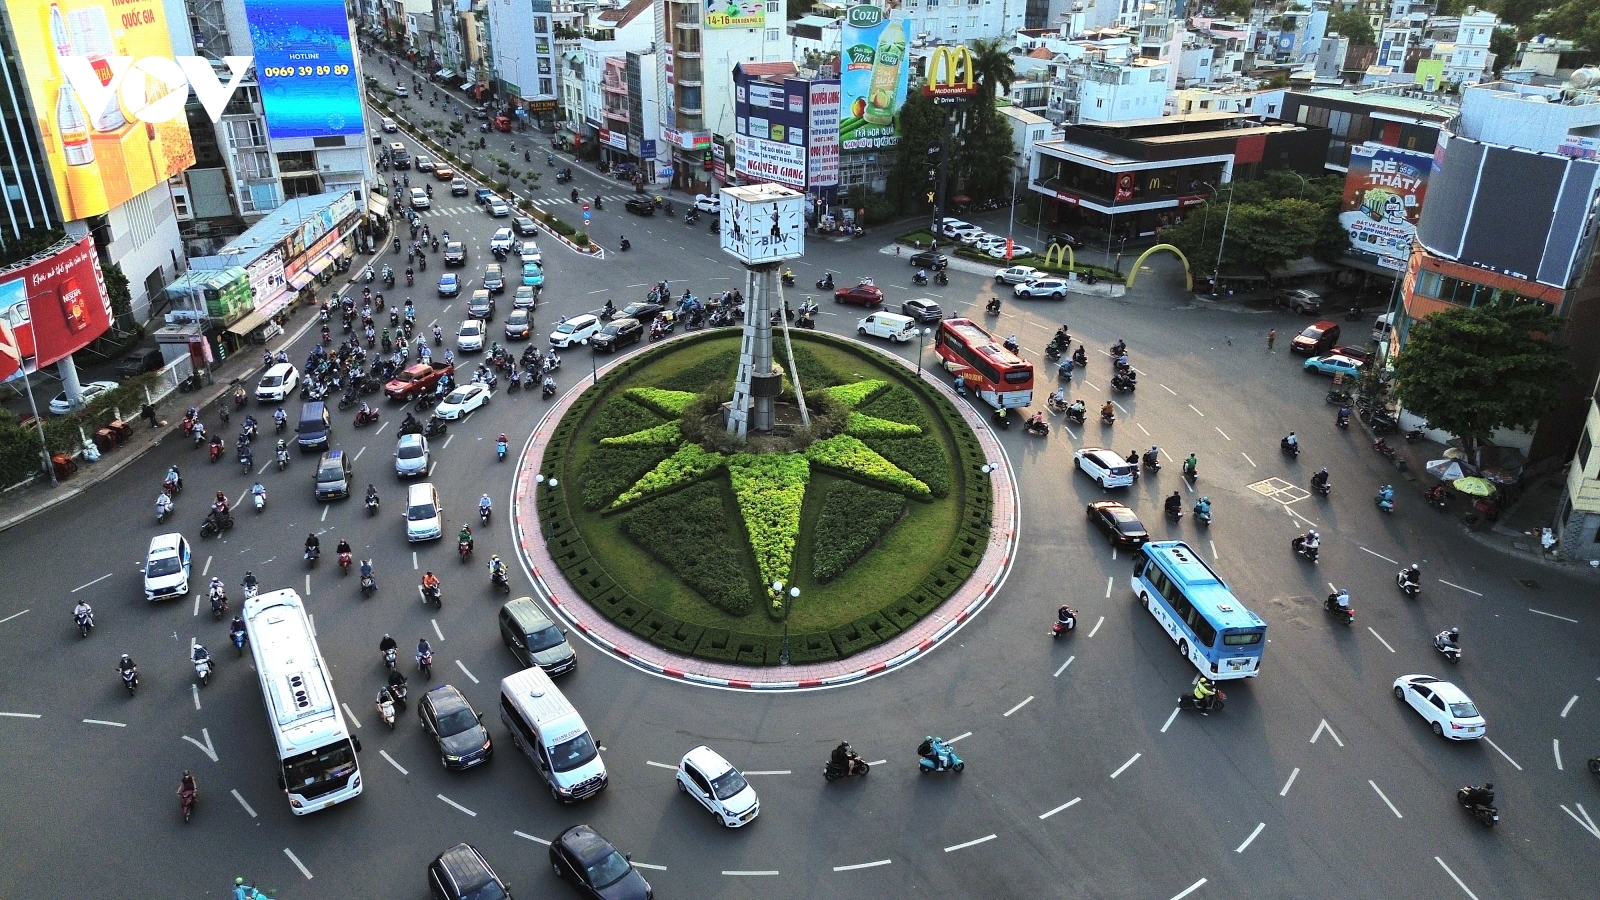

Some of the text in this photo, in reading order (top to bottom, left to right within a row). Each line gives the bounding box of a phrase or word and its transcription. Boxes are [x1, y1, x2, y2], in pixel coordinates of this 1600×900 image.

[142, 9, 156, 25] GIA
[707, 15, 731, 25] 14-16
[851, 9, 879, 23] Cozy
[881, 53, 898, 66] Cozy
[264, 64, 349, 78] 0969 39 89 89
[750, 91, 769, 99] Panasonic
[934, 87, 967, 95] McDonald's
[854, 126, 866, 138] TRÀ
[867, 128, 880, 137] HOA
[1370, 157, 1398, 174] RẺ
[780, 166, 804, 181] GIANG
[1368, 173, 1422, 194] THẬT!
[761, 232, 789, 246] BIDV
